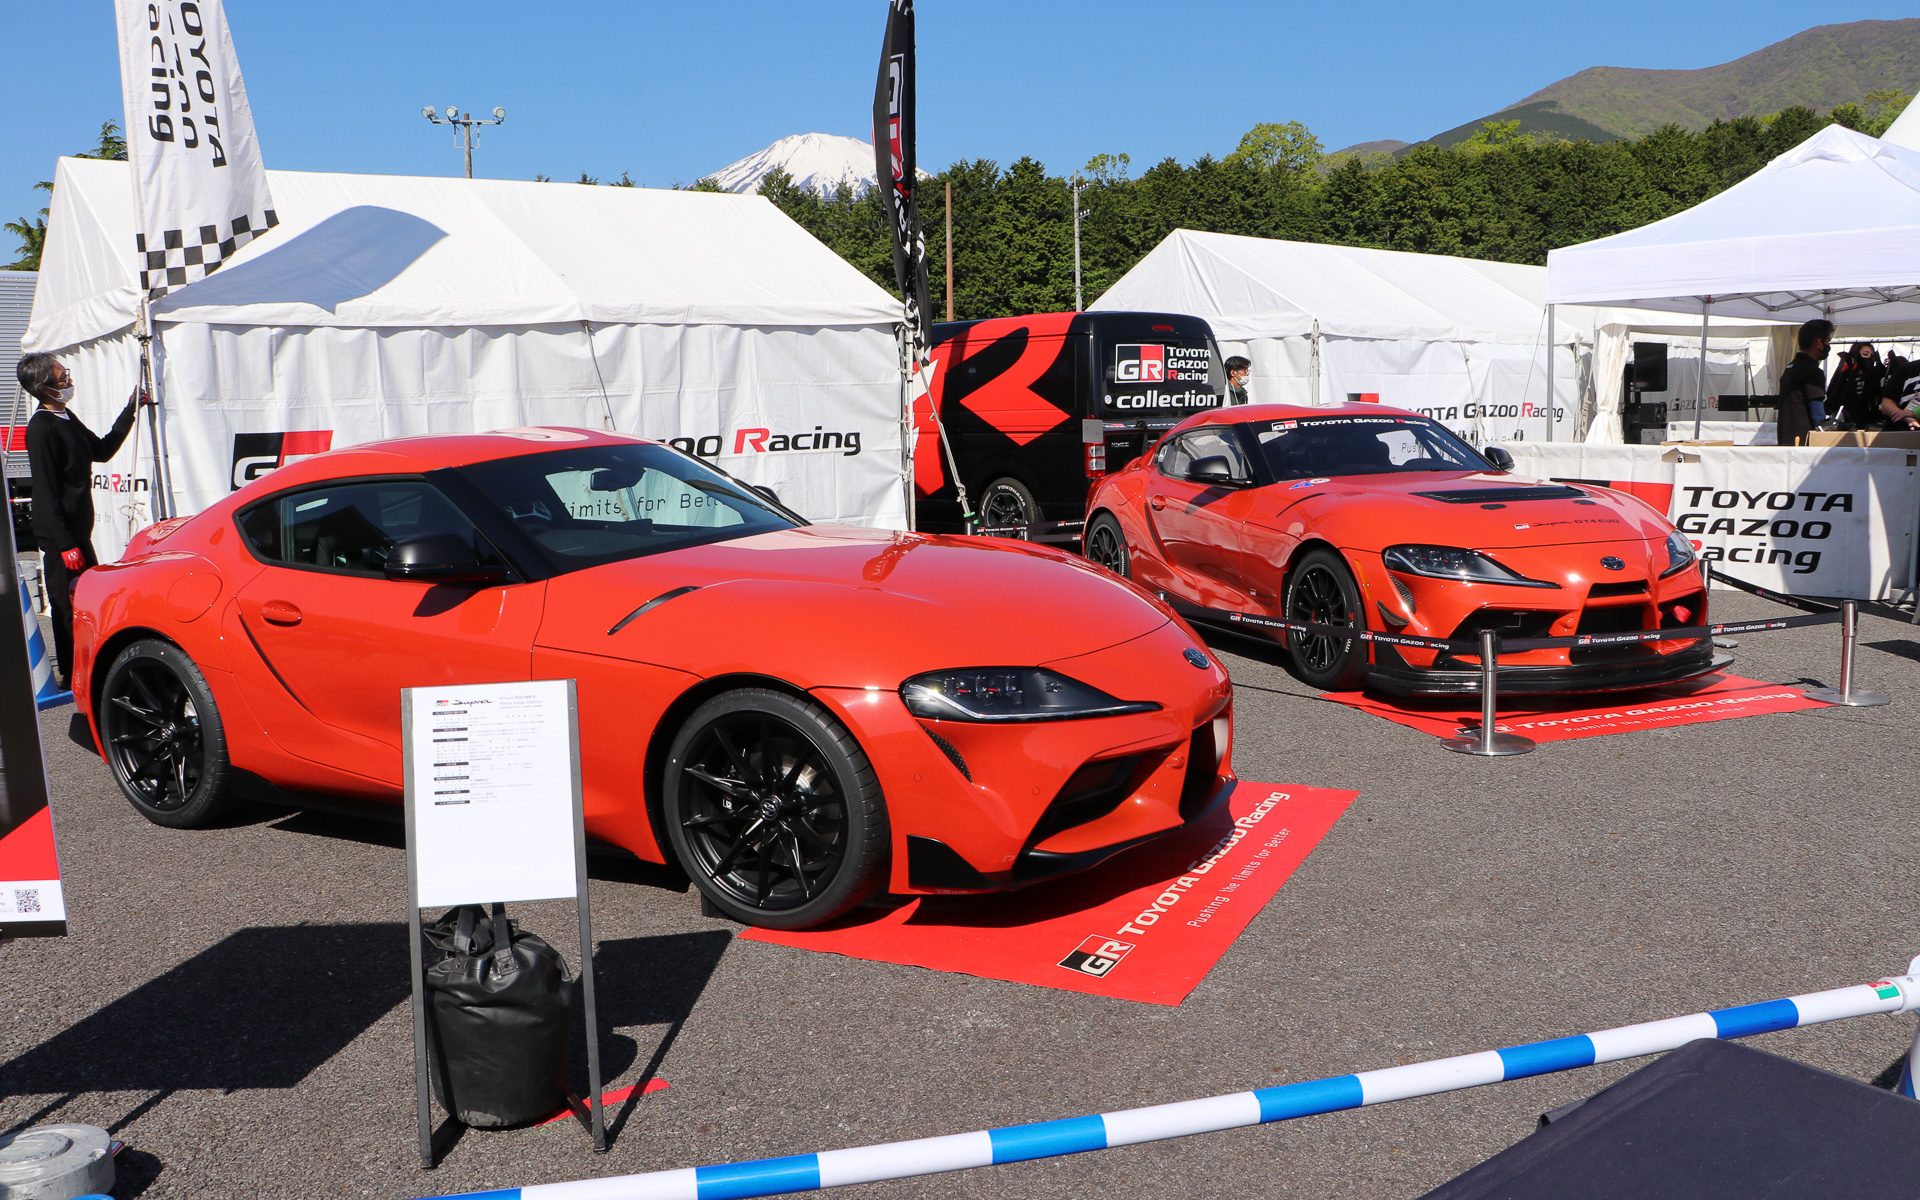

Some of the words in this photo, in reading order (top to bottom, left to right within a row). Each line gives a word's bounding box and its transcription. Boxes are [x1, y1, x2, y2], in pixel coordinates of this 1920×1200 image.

[148, 3, 175, 143] acing
[181, 0, 228, 168] OYOTA
[1166, 346, 1212, 358] TOYOTA
[1117, 359, 1163, 380] GR
[1167, 358, 1209, 369] GAZOO
[1167, 370, 1209, 384] Racing
[1116, 389, 1218, 409] collection
[1300, 418, 1352, 427] TOYOTA
[1395, 418, 1431, 427] Racing
[1463, 402, 1518, 419] GAZOO
[1521, 402, 1564, 423] Racng
[733, 425, 861, 457] Racing
[569, 499, 622, 518] imits
[637, 496, 666, 513] for
[1682, 486, 1853, 513] TOYOTA
[1676, 513, 1832, 539] GAZOO
[1241, 616, 1263, 625] TOYOTA
[1264, 620, 1285, 628] GAZOO
[1285, 623, 1307, 632] Racing
[1373, 635, 1399, 643] TOYOTA
[1400, 638, 1424, 646] GAZOO
[1425, 641, 1450, 650] Racing
[451, 698, 494, 707] Supra
[1515, 712, 1624, 729] TOYOTA
[1624, 700, 1715, 717] GAZOO
[1714, 692, 1798, 705] Racing
[1563, 722, 1618, 733] Pushing
[1643, 714, 1682, 723] limits
[1708, 706, 1747, 715] Better
[1080, 940, 1131, 975] GR
[1116, 876, 1200, 936] TOYOTA
[1187, 828, 1247, 875] GAZOO
[1234, 791, 1291, 829] Racing
[1186, 896, 1230, 928] Pushing
[1219, 876, 1241, 894] the
[1232, 858, 1261, 883] limits
[1253, 846, 1272, 860] for
[1264, 827, 1291, 849] Better
